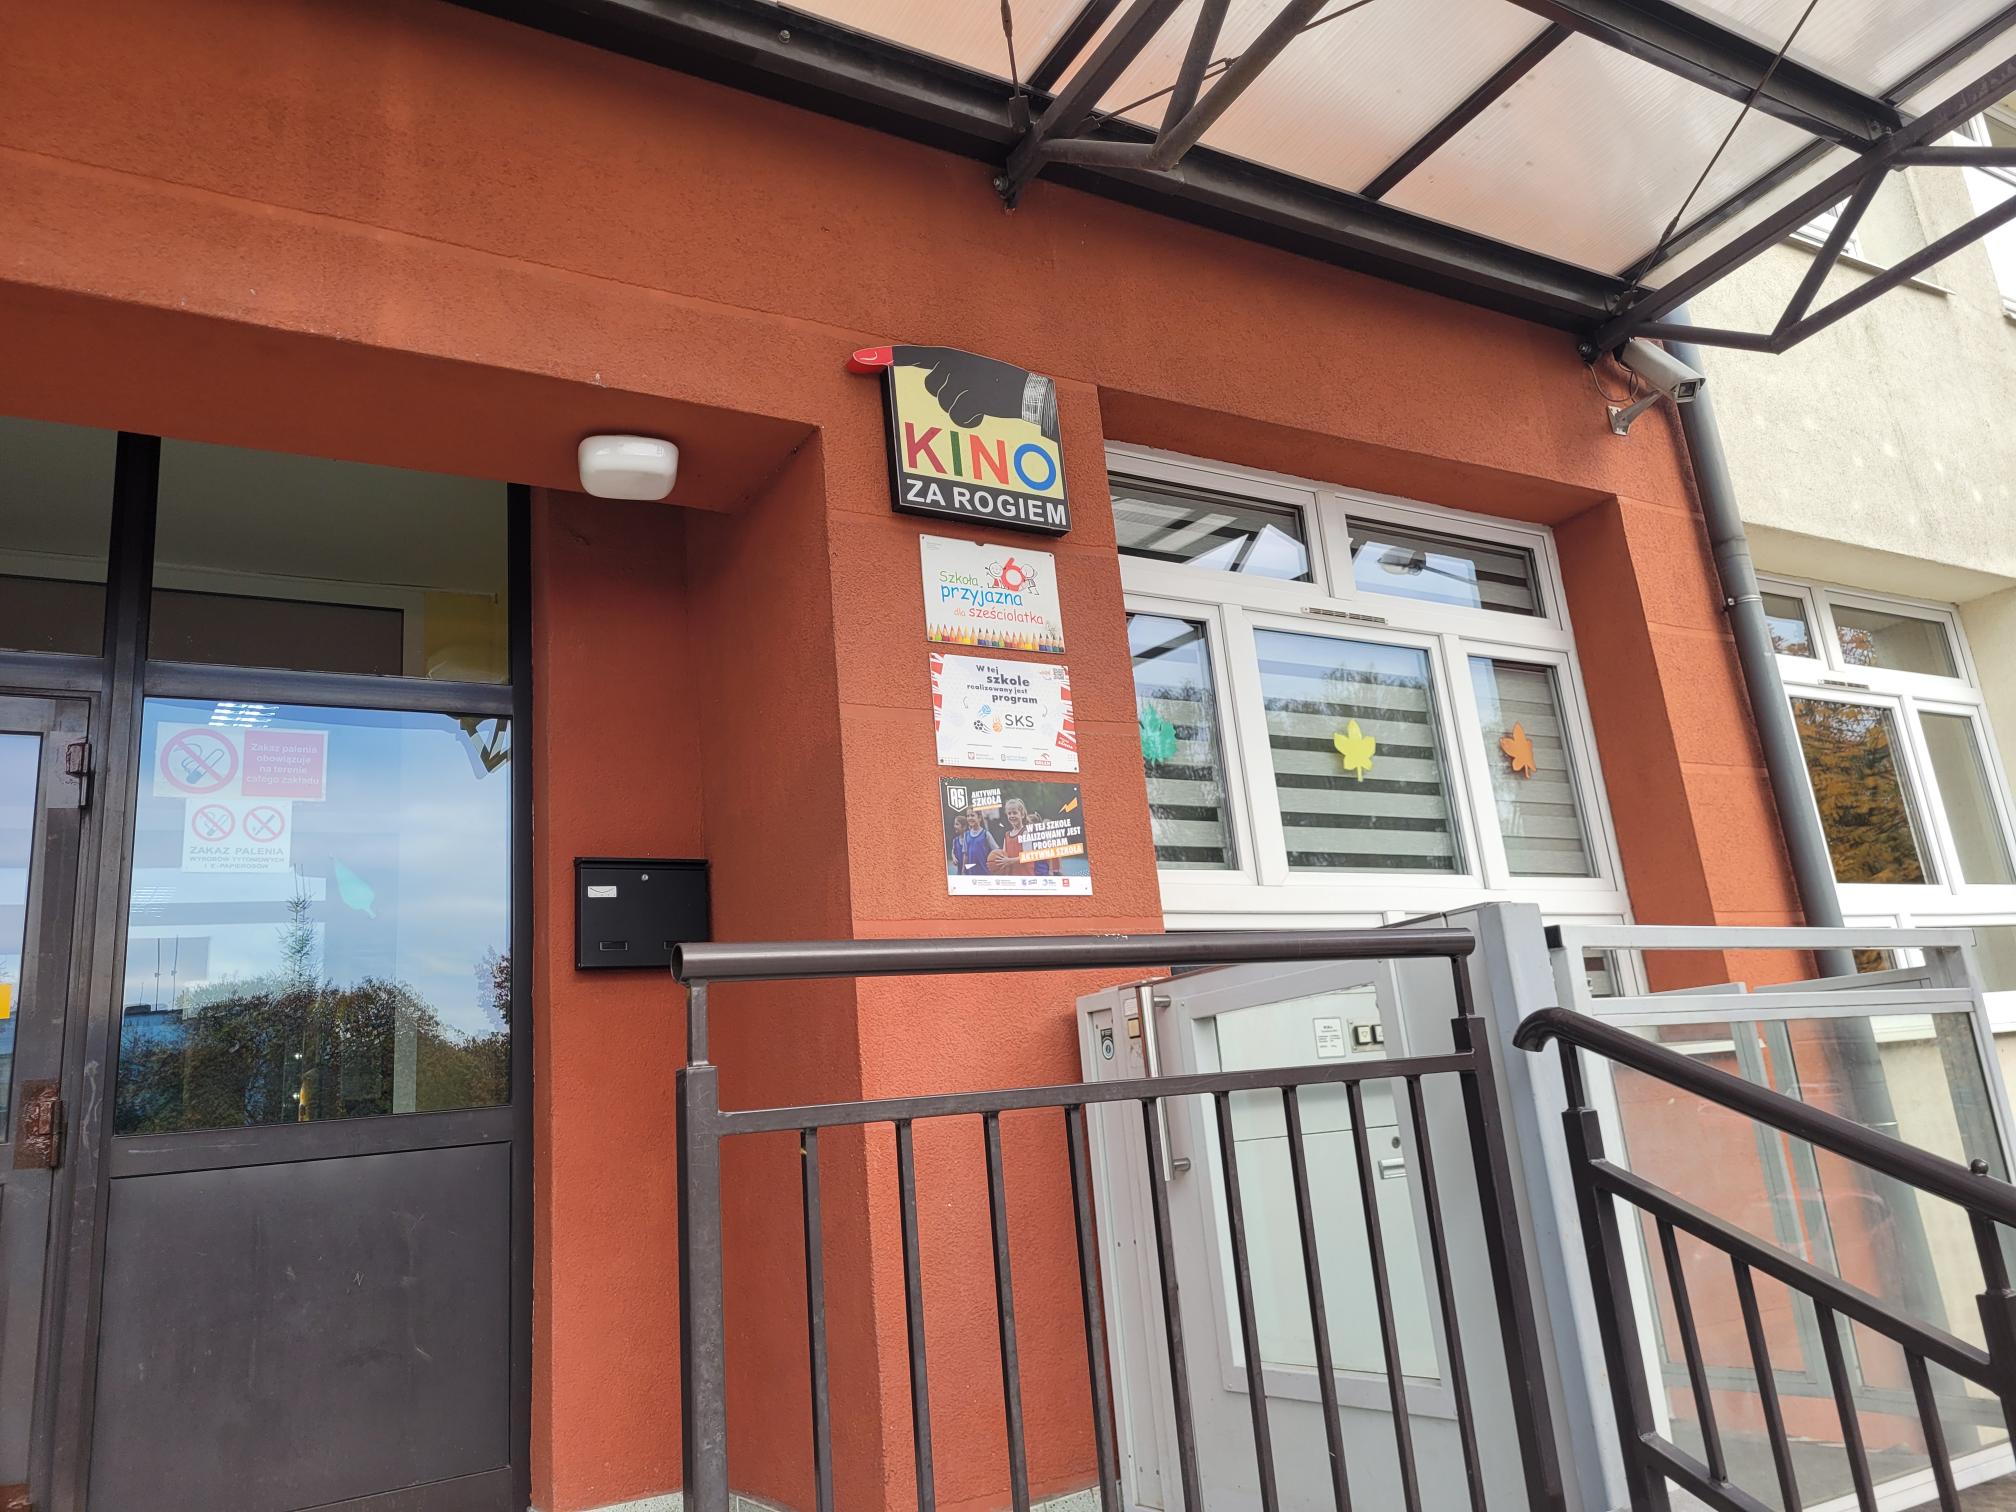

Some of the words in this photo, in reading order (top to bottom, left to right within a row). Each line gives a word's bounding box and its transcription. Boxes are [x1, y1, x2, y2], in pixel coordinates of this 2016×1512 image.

[904, 421, 1057, 491] KINO
[906, 478, 946, 506] ZA
[952, 486, 1067, 526] ROGIEM
[939, 570, 979, 586] Szkoła
[940, 584, 1024, 607] przyjazna
[953, 608, 966, 617] dla
[968, 606, 1044, 625] sześciolatka
[976, 664, 986, 672] W
[987, 665, 999, 675] tej
[986, 674, 1030, 687] szkole
[966, 684, 1013, 694] realizowany
[1014, 686, 1028, 694] jest
[992, 693, 1038, 704] program
[1004, 713, 1035, 728] SKS
[251, 743, 280, 752] Zakaz
[282, 744, 318, 754] palenia
[256, 755, 311, 766] obowiązuje
[274, 766, 308, 774] terenie
[246, 775, 280, 785] całego
[281, 776, 319, 785] zakładu
[971, 788, 1001, 798] AKTYWNA
[972, 795, 1003, 807] SZKOŁA
[1026, 824, 1034, 832] W
[1035, 823, 1046, 831] TEJ
[1046, 819, 1072, 829] SZKOLE
[1018, 828, 1066, 843] REALIZOWANY
[1067, 826, 1081, 836] JEST
[1033, 837, 1069, 850] PROGRAM
[190, 846, 230, 855] ZAKAZ
[235, 847, 284, 855] PALENIA
